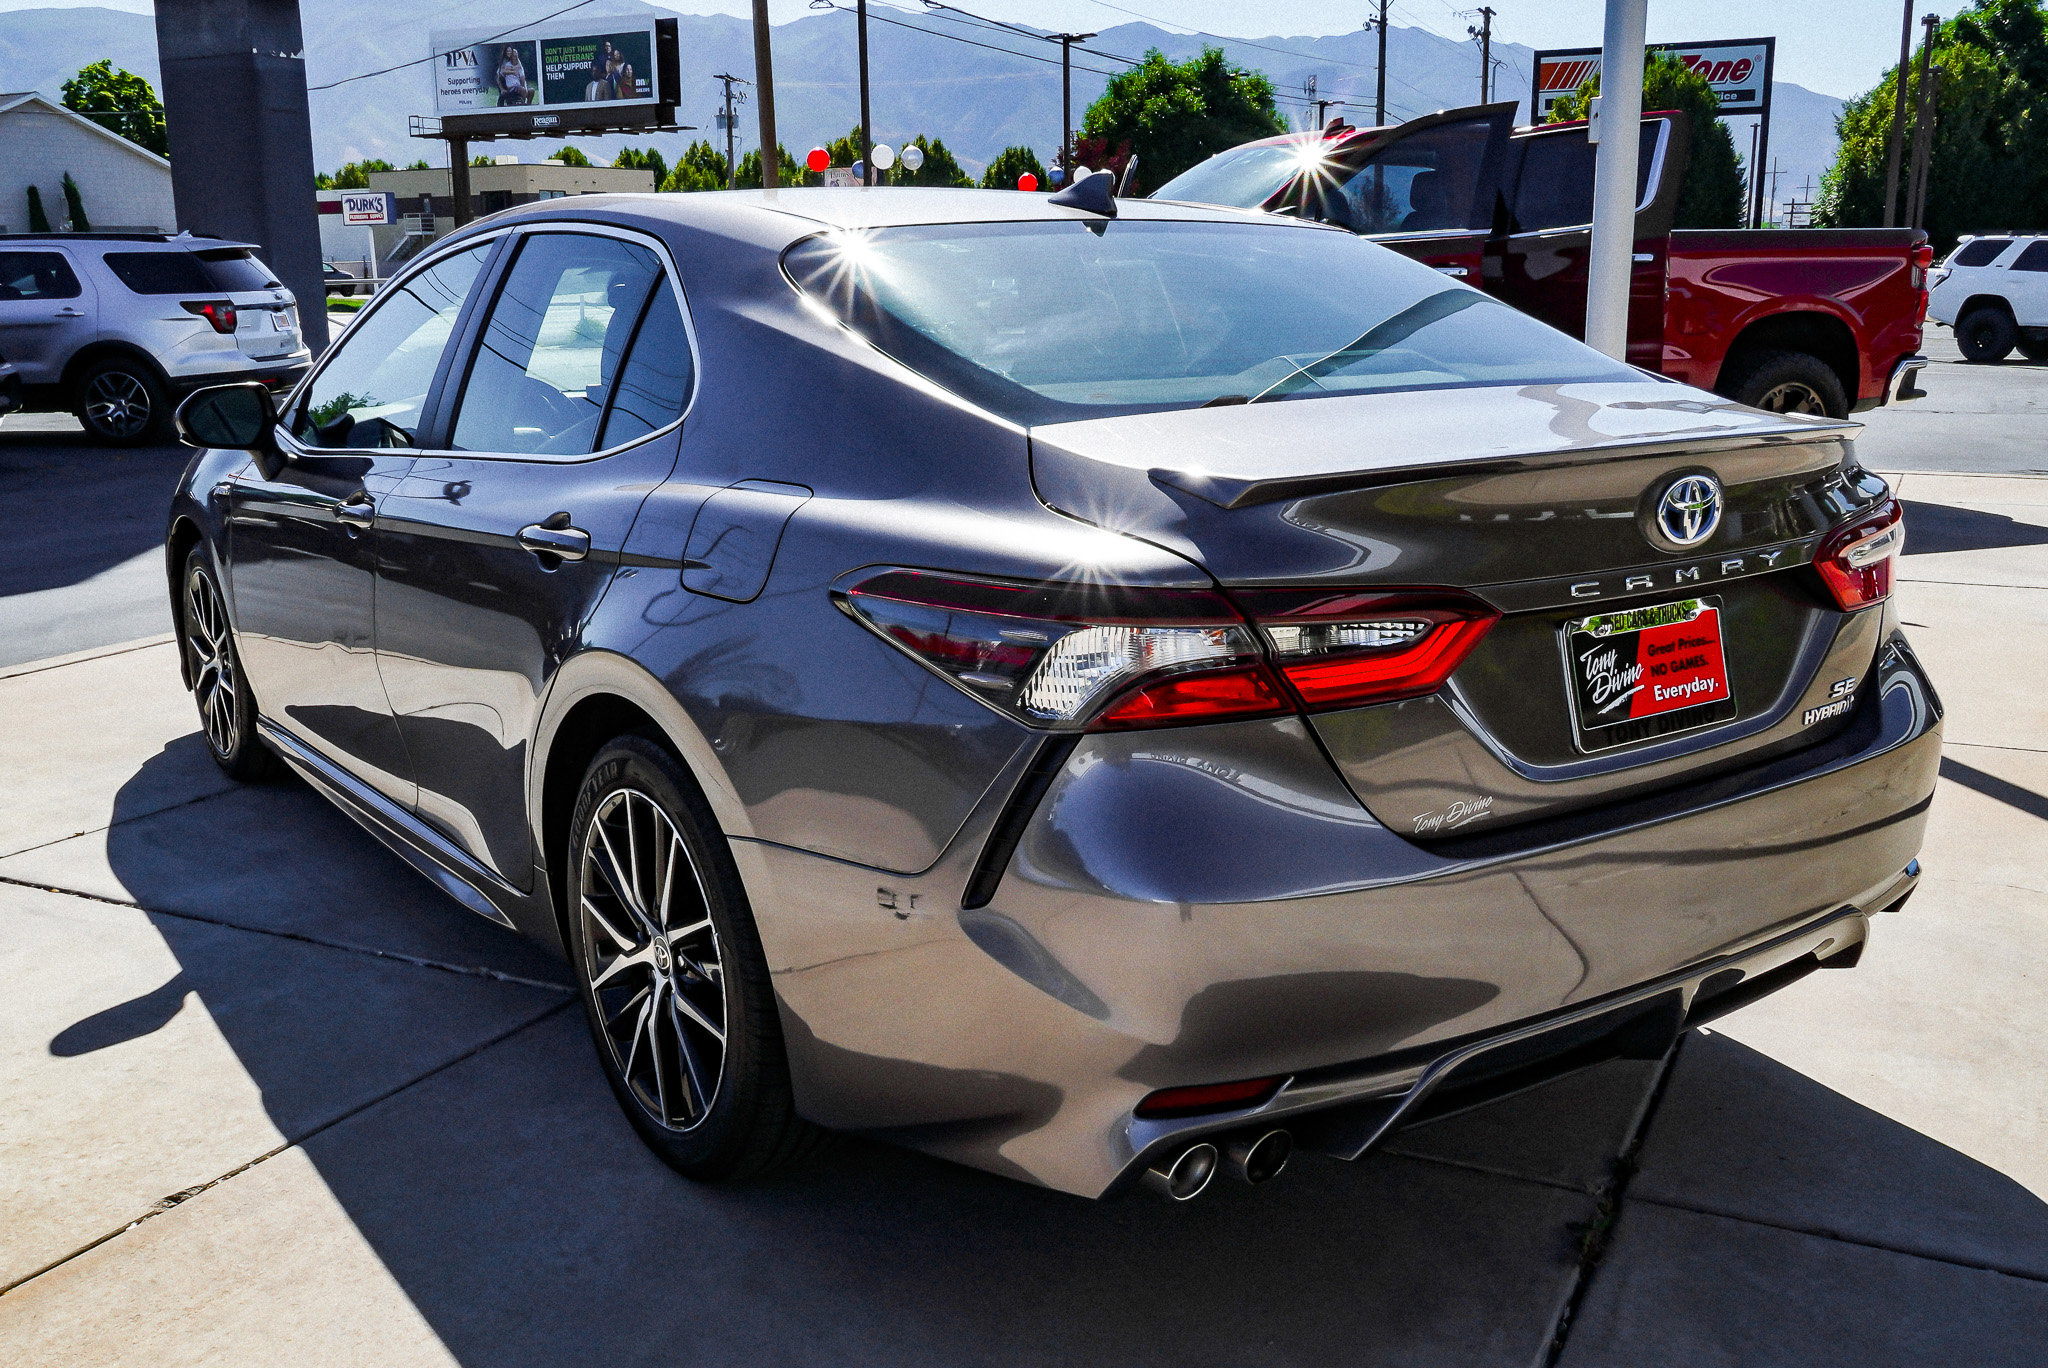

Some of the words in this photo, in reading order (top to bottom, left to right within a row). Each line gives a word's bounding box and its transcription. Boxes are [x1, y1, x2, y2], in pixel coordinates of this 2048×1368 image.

[545, 47, 562, 55] DON'T
[563, 46, 576, 54] JUST
[577, 44, 597, 52] THANK
[546, 55, 560, 63] OUR
[560, 52, 595, 61] VETERANS
[546, 63, 562, 72] HELP
[563, 61, 592, 71] SUPPORT
[547, 72, 565, 80] THEM
[440, 88, 461, 96] heroes
[462, 86, 489, 95] everyday
[447, 76, 481, 86] Supporting
[533, 116, 558, 127] Reagan
[344, 196, 384, 213] DURK'S
[1570, 550, 1782, 598] CAMRY
[1627, 609, 1648, 627] CARS
[1656, 602, 1687, 622] TRUCKS
[1647, 643, 1676, 657] Great
[1580, 643, 1618, 680] Tony
[1650, 662, 1668, 678] NO
[1670, 654, 1710, 674] GAMES.
[1586, 663, 1644, 704] Divino
[1653, 676, 1719, 701] Everyday.
[1829, 676, 1856, 699] SE
[1802, 696, 1852, 725] HYBRID
[1413, 811, 1445, 834] Tony
[1446, 796, 1492, 823] Divino
